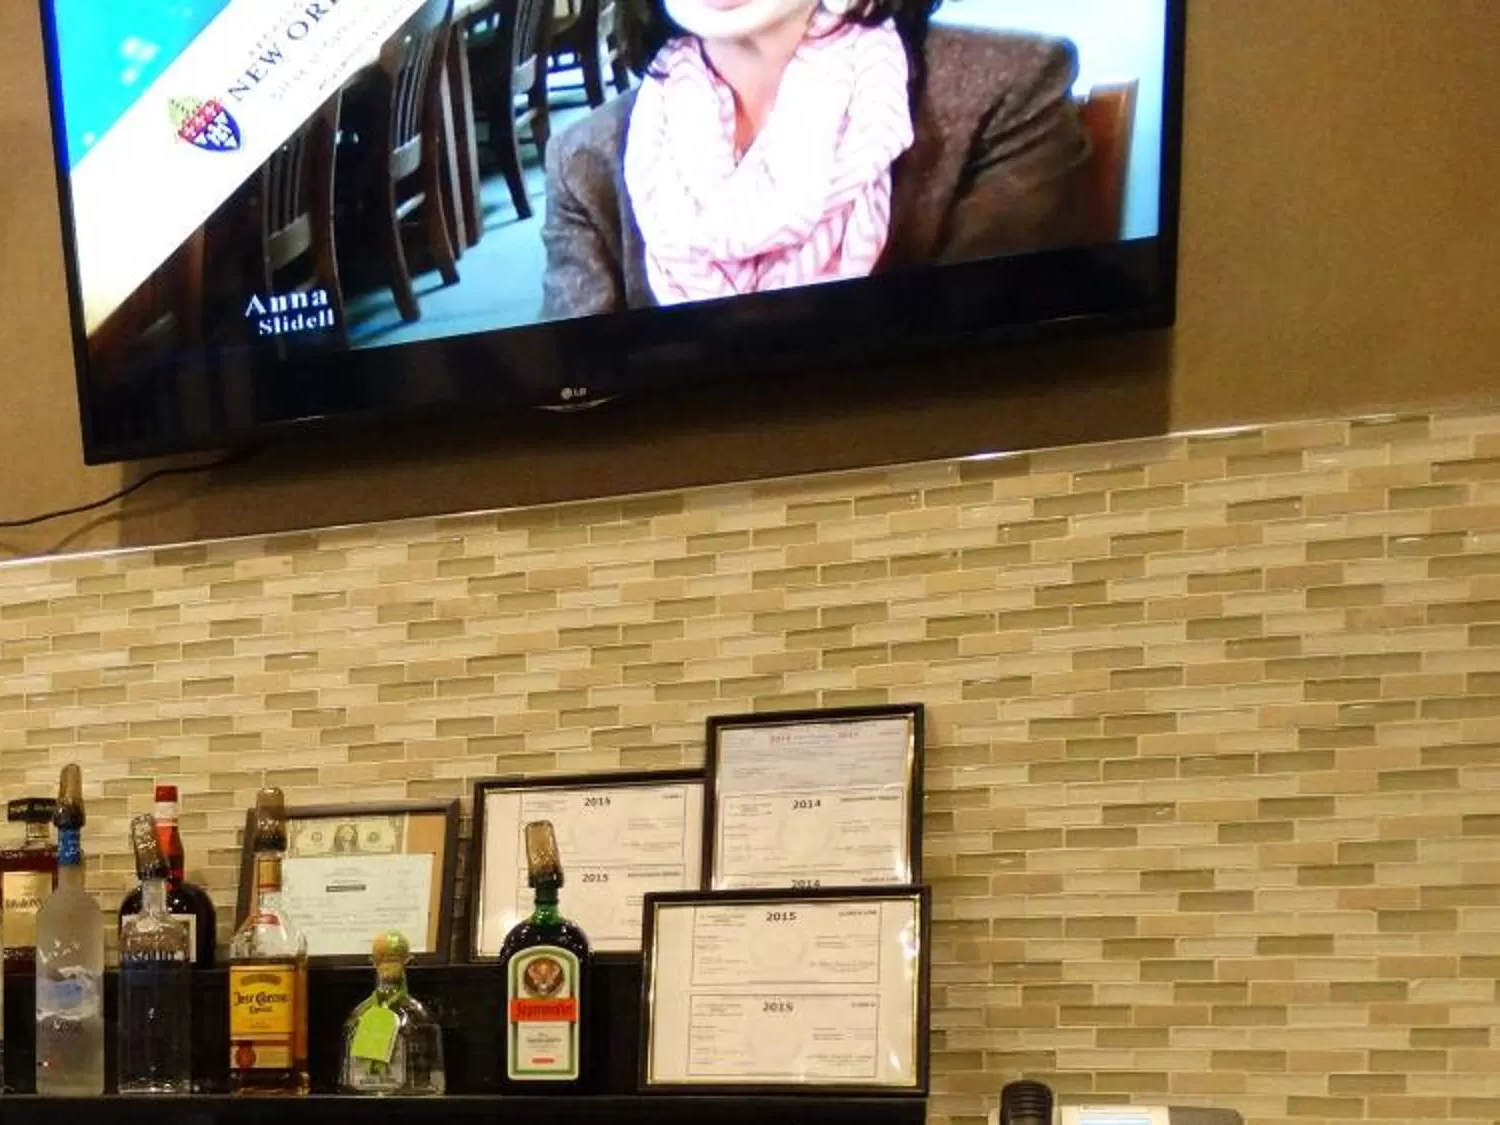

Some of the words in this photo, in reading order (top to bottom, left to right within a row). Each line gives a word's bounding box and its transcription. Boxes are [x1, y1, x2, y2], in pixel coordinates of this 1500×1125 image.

[227, 42, 283, 102] NEW
[286, 0, 342, 41] OR
[244, 289, 329, 317] Anna
[259, 307, 335, 335] Slidell
[792, 799, 822, 810] 2014
[765, 911, 798, 923] 2015
